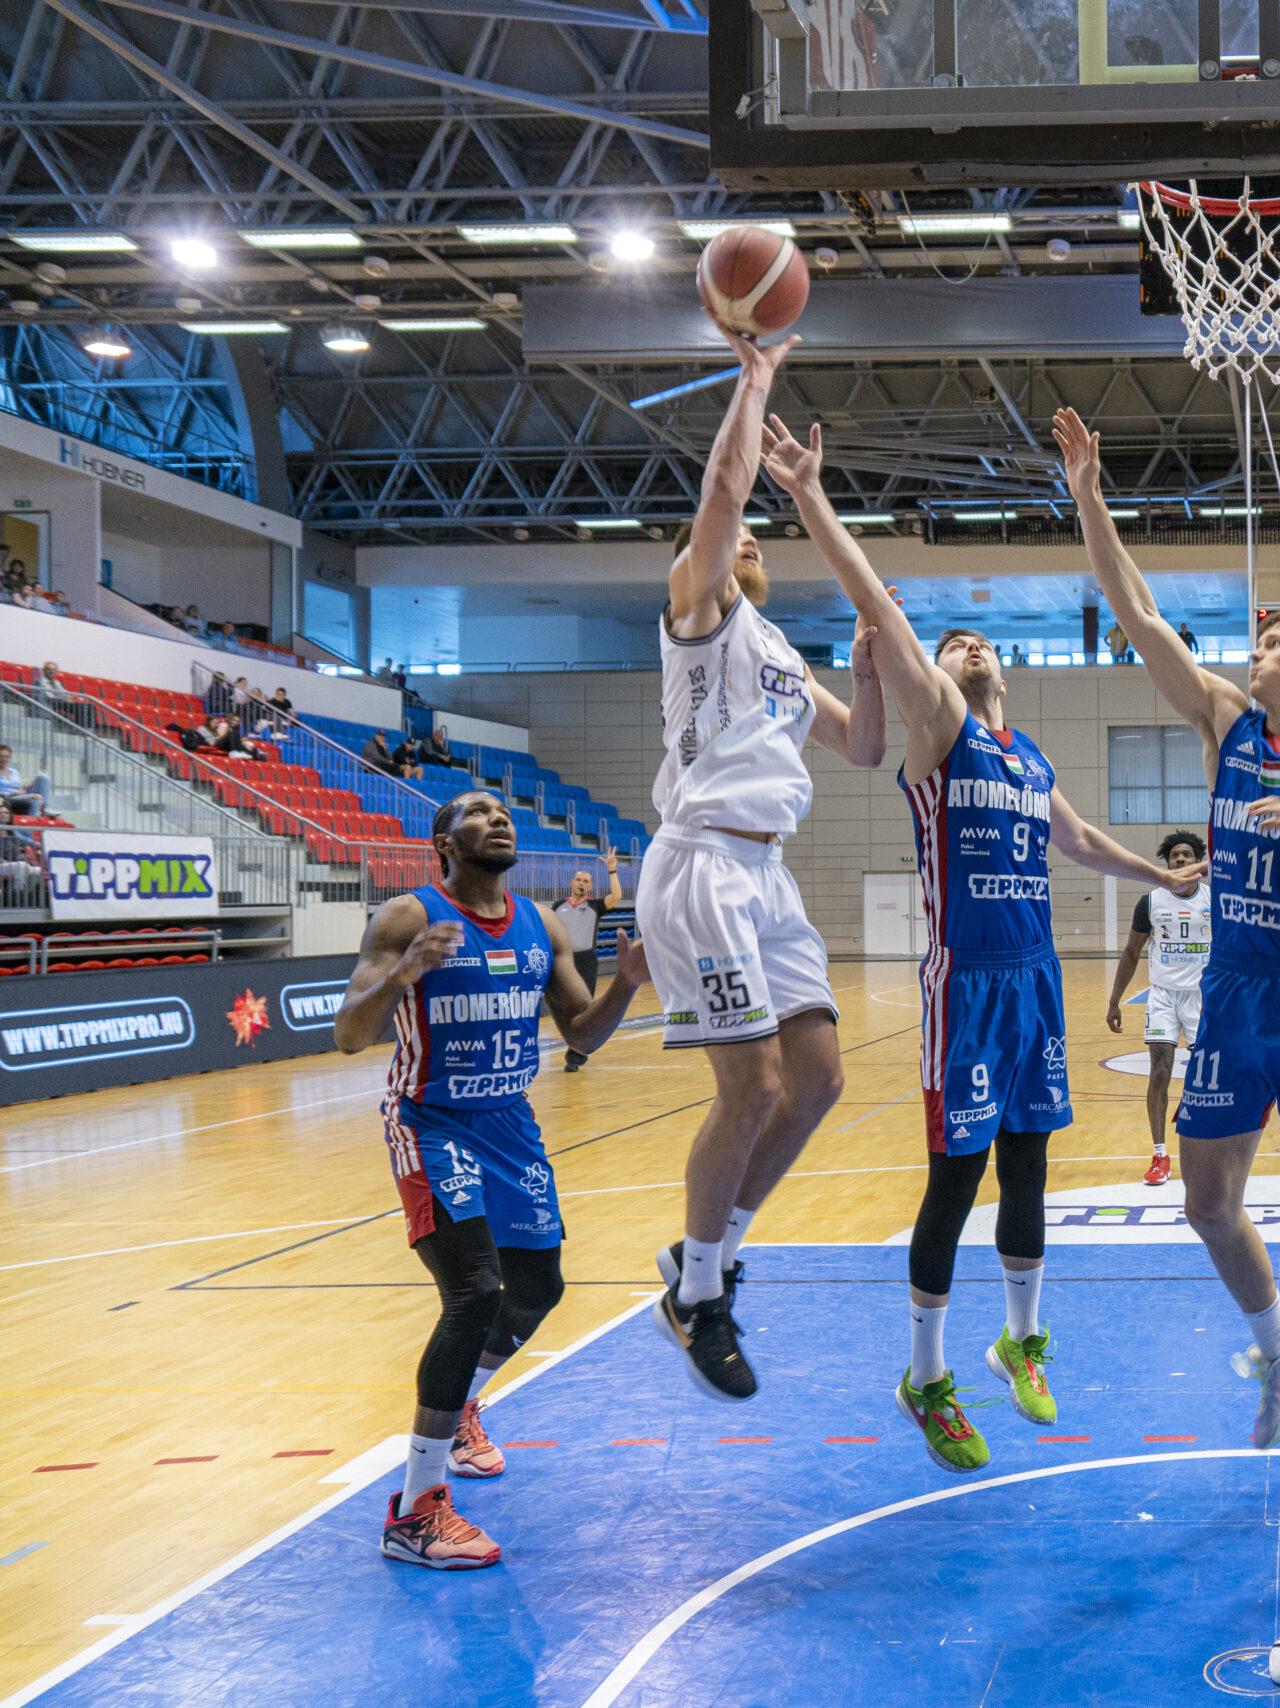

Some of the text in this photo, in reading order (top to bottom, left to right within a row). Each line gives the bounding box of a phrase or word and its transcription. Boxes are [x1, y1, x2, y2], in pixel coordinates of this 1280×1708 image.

[960, 828, 1000, 840] MVM
[1013, 822, 1030, 862] 9
[1213, 848, 1238, 865] MVM
[1245, 846, 1274, 894] 11
[1181, 922, 1188, 938] 0
[701, 971, 751, 1013] 35
[3, 1011, 184, 1055] WWW.TIPPMIXPRO.HU
[445, 1040, 486, 1051] MVM
[491, 1030, 521, 1069] 15
[972, 1063, 989, 1102] 9
[1047, 1072, 1065, 1080] PAKS
[1192, 1048, 1221, 1091] 11
[443, 1141, 480, 1175] 15
